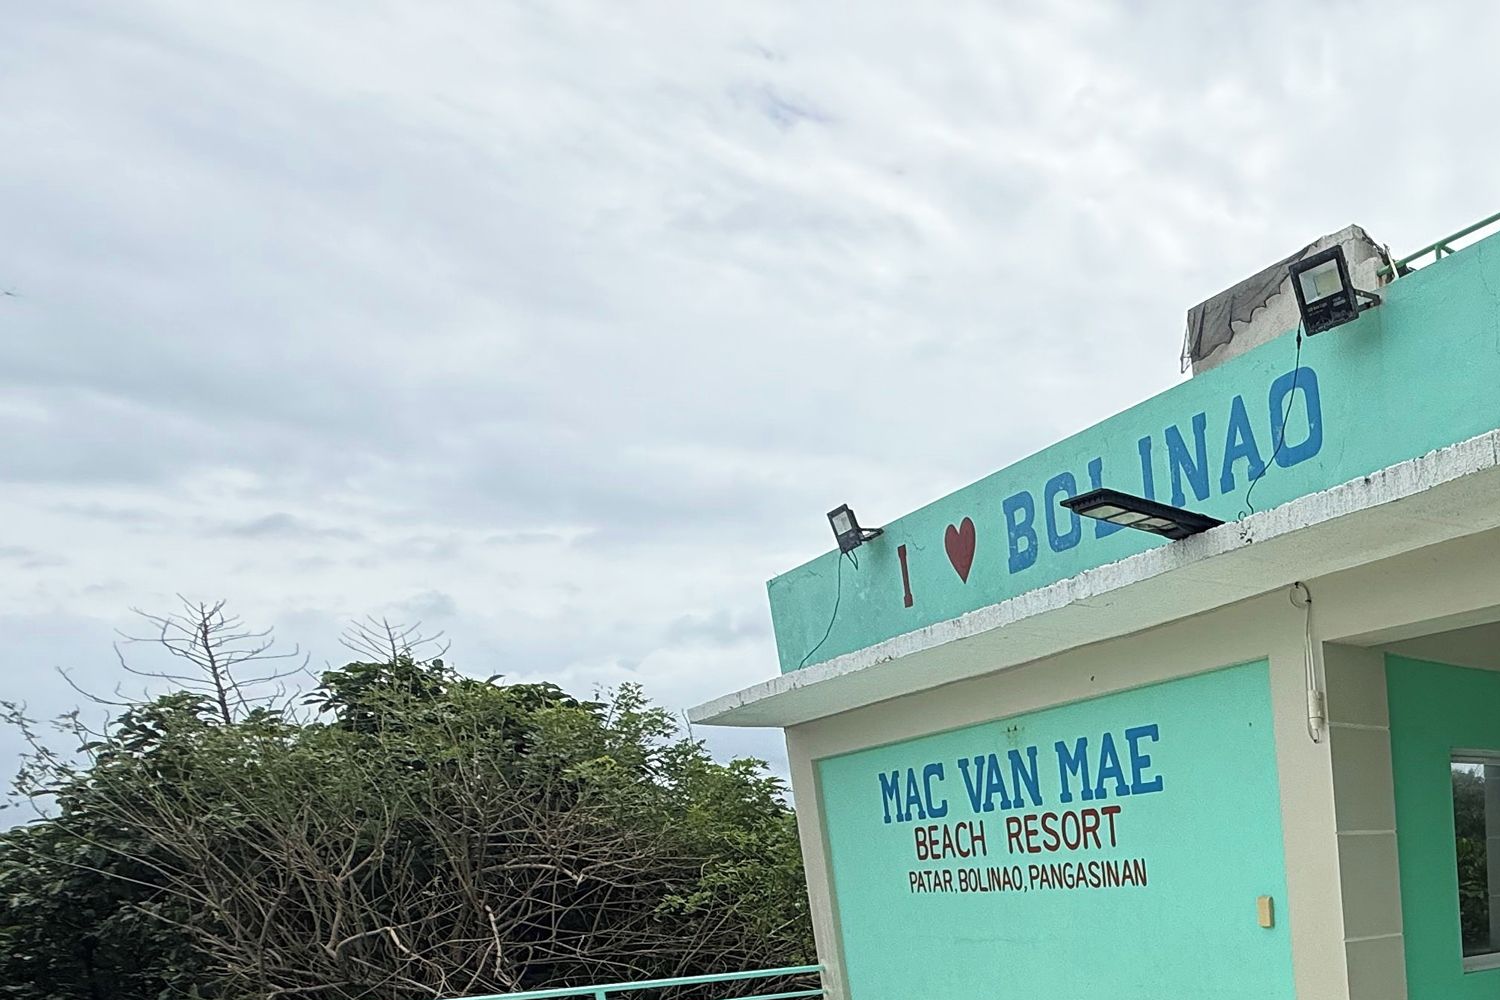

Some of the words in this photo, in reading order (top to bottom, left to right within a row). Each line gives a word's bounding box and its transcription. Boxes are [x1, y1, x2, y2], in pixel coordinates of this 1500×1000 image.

[898, 544, 914, 608] I
[1002, 365, 1323, 574] BOLINAO
[878, 762, 948, 824] MAC
[958, 745, 1043, 813] VAN
[1054, 723, 1164, 803] MAE
[914, 819, 987, 861] BEACH
[1006, 805, 1122, 854] RESORT
